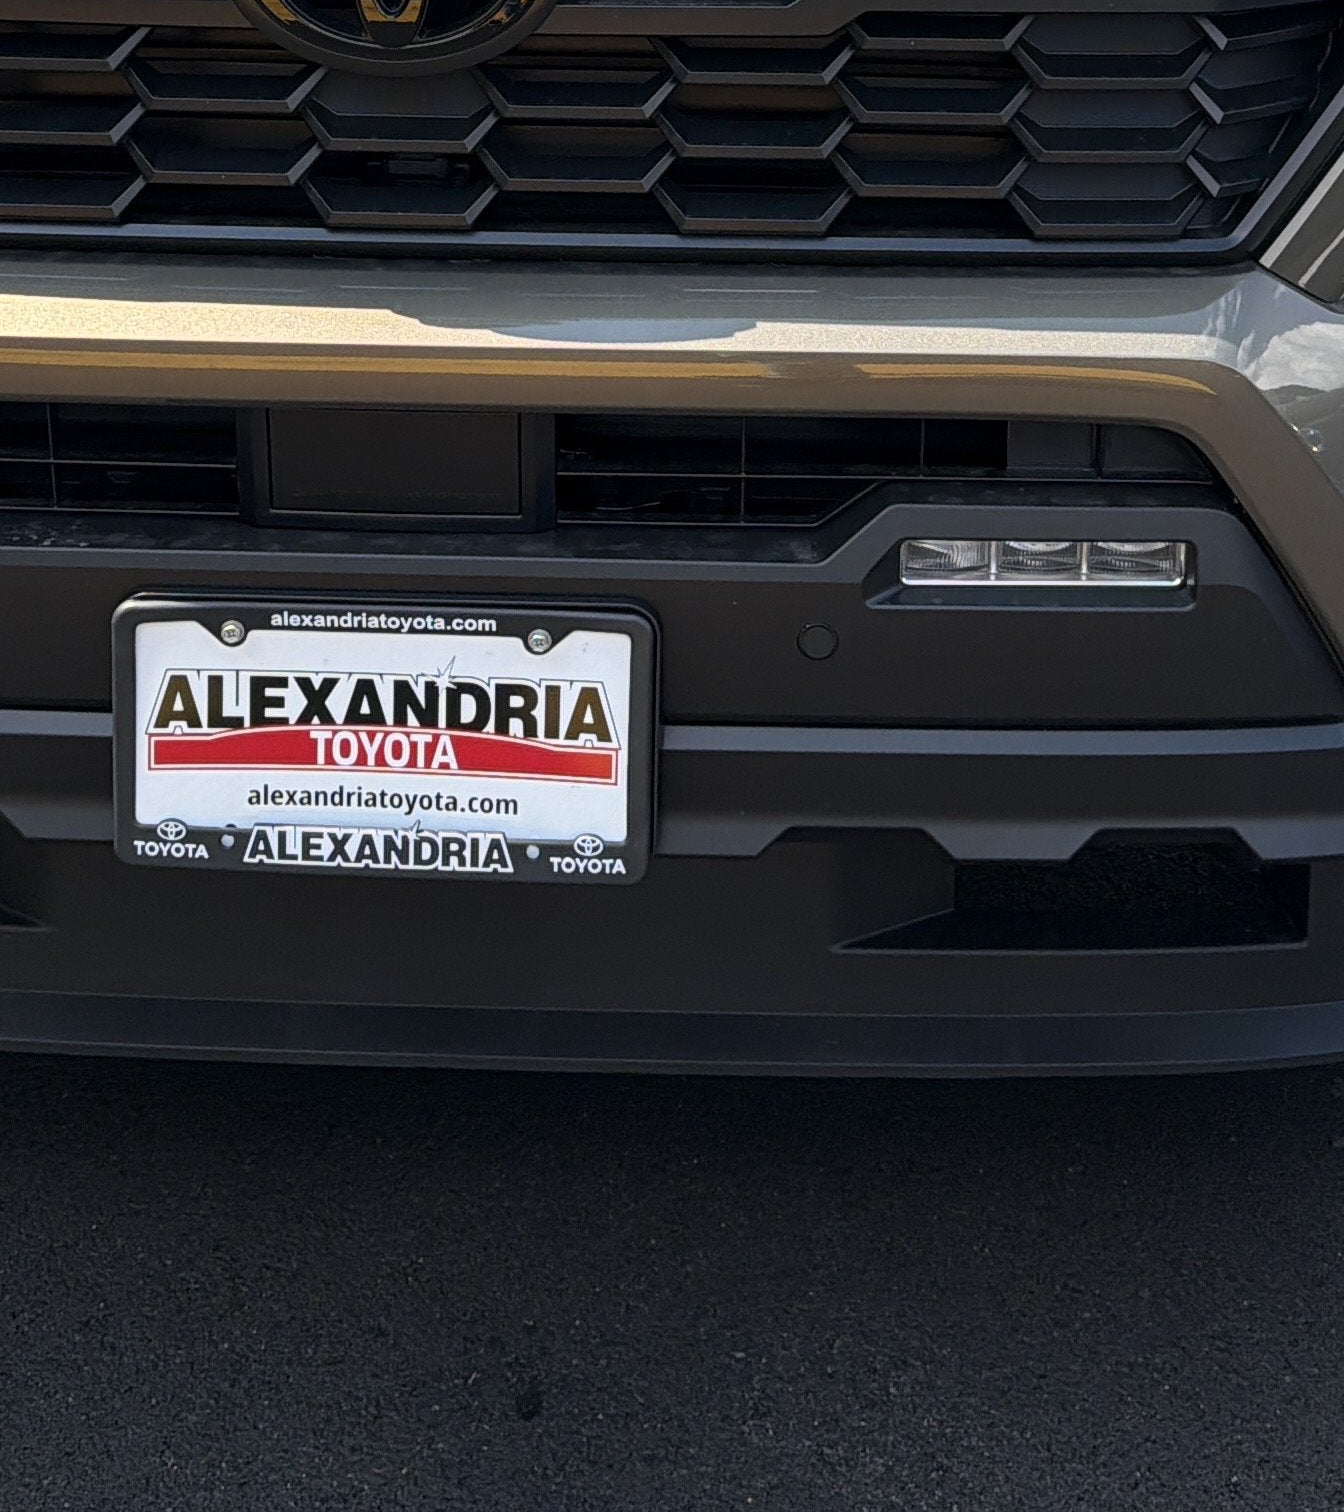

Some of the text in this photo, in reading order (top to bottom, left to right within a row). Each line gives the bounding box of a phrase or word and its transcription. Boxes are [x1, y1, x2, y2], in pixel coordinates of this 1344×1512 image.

[270, 610, 497, 633] alexandriatoyota.com
[152, 673, 615, 744] ALEXANDRIA
[310, 731, 459, 770] TOYOTA
[247, 784, 519, 815] alexandriatoyota.com
[133, 840, 210, 859] TOYOTA
[244, 826, 514, 873] ALEXANDRIA
[549, 856, 627, 875] TOYOTA
